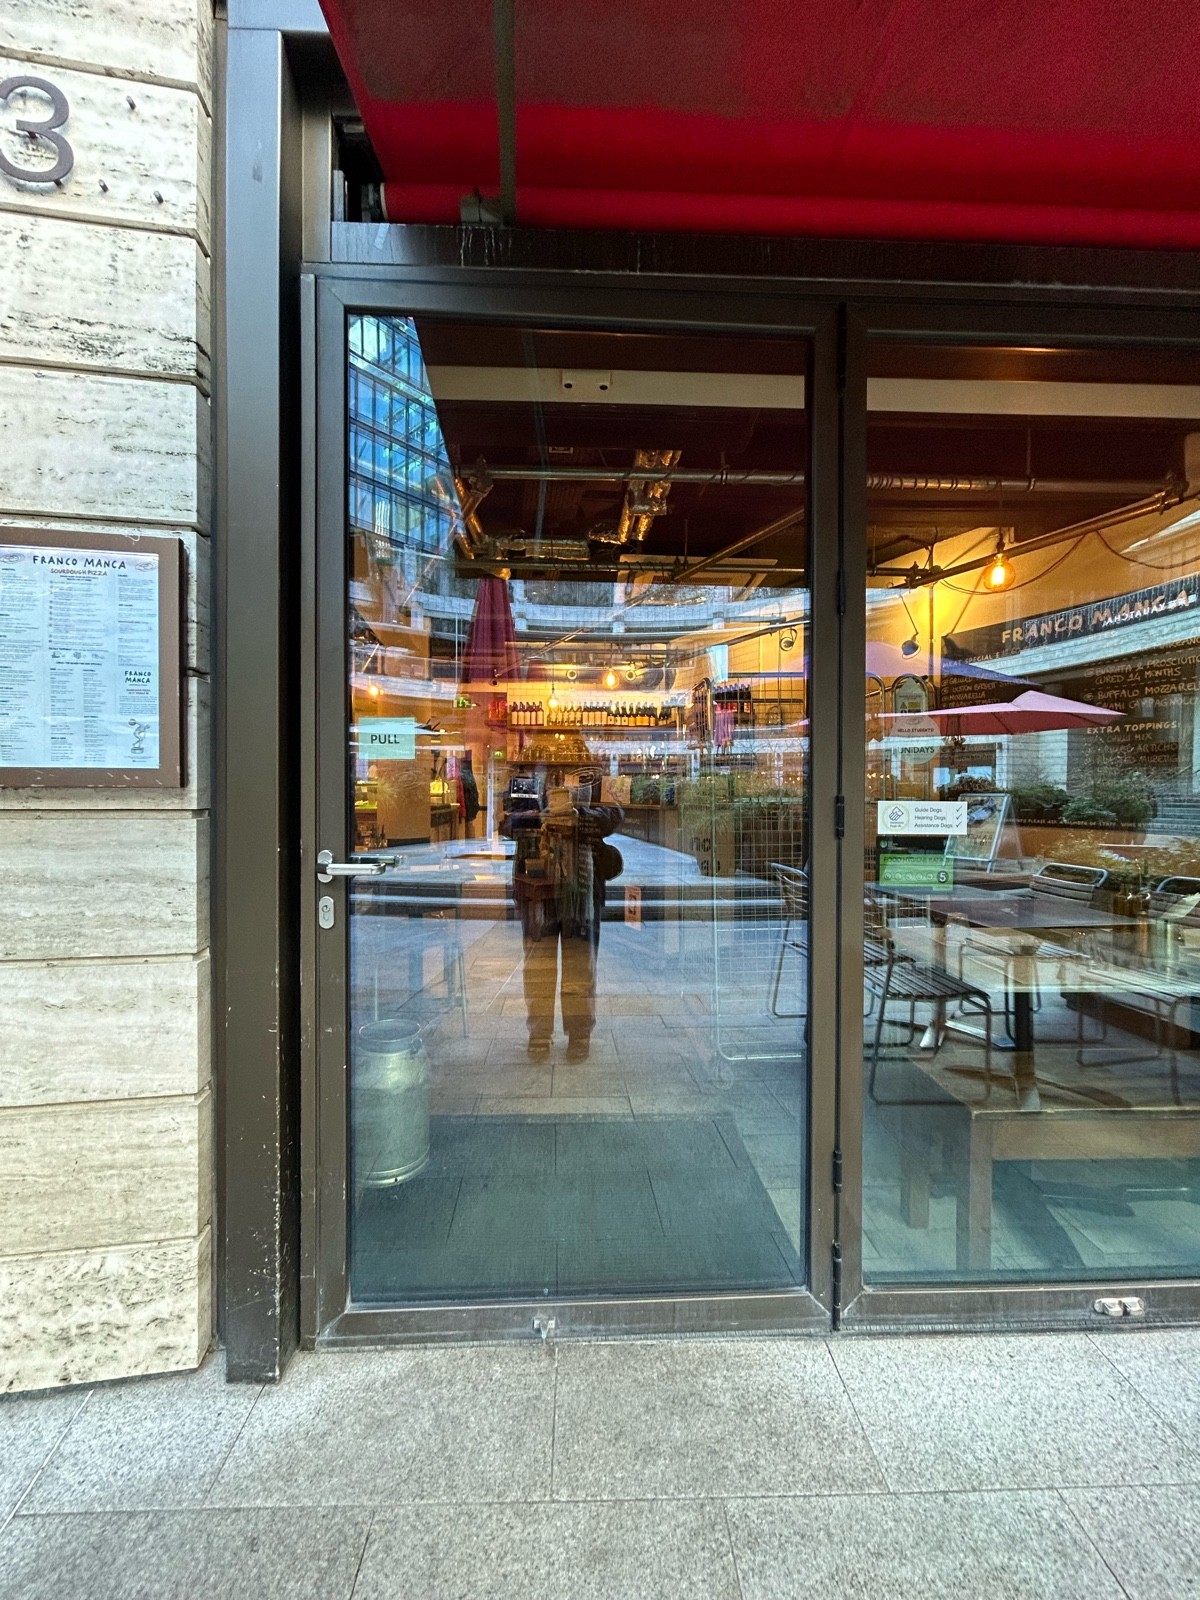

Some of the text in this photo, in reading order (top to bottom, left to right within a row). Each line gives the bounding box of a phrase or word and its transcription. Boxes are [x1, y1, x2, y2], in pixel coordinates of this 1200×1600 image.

[0, 76, 74, 182] 3
[33, 555, 127, 569] FRANCO MANCA
[1001, 590, 1190, 643] FRANCO MANCA
[964, 653, 993, 664] SPECIAL
[1095, 674, 1125, 685] CURED
[1144, 667, 1182, 679] MONTHS
[1097, 689, 1140, 700] BUFFALO
[1086, 725, 1121, 735] EXTRA
[370, 734, 400, 744] PULL
[939, 871, 947, 882] 5
